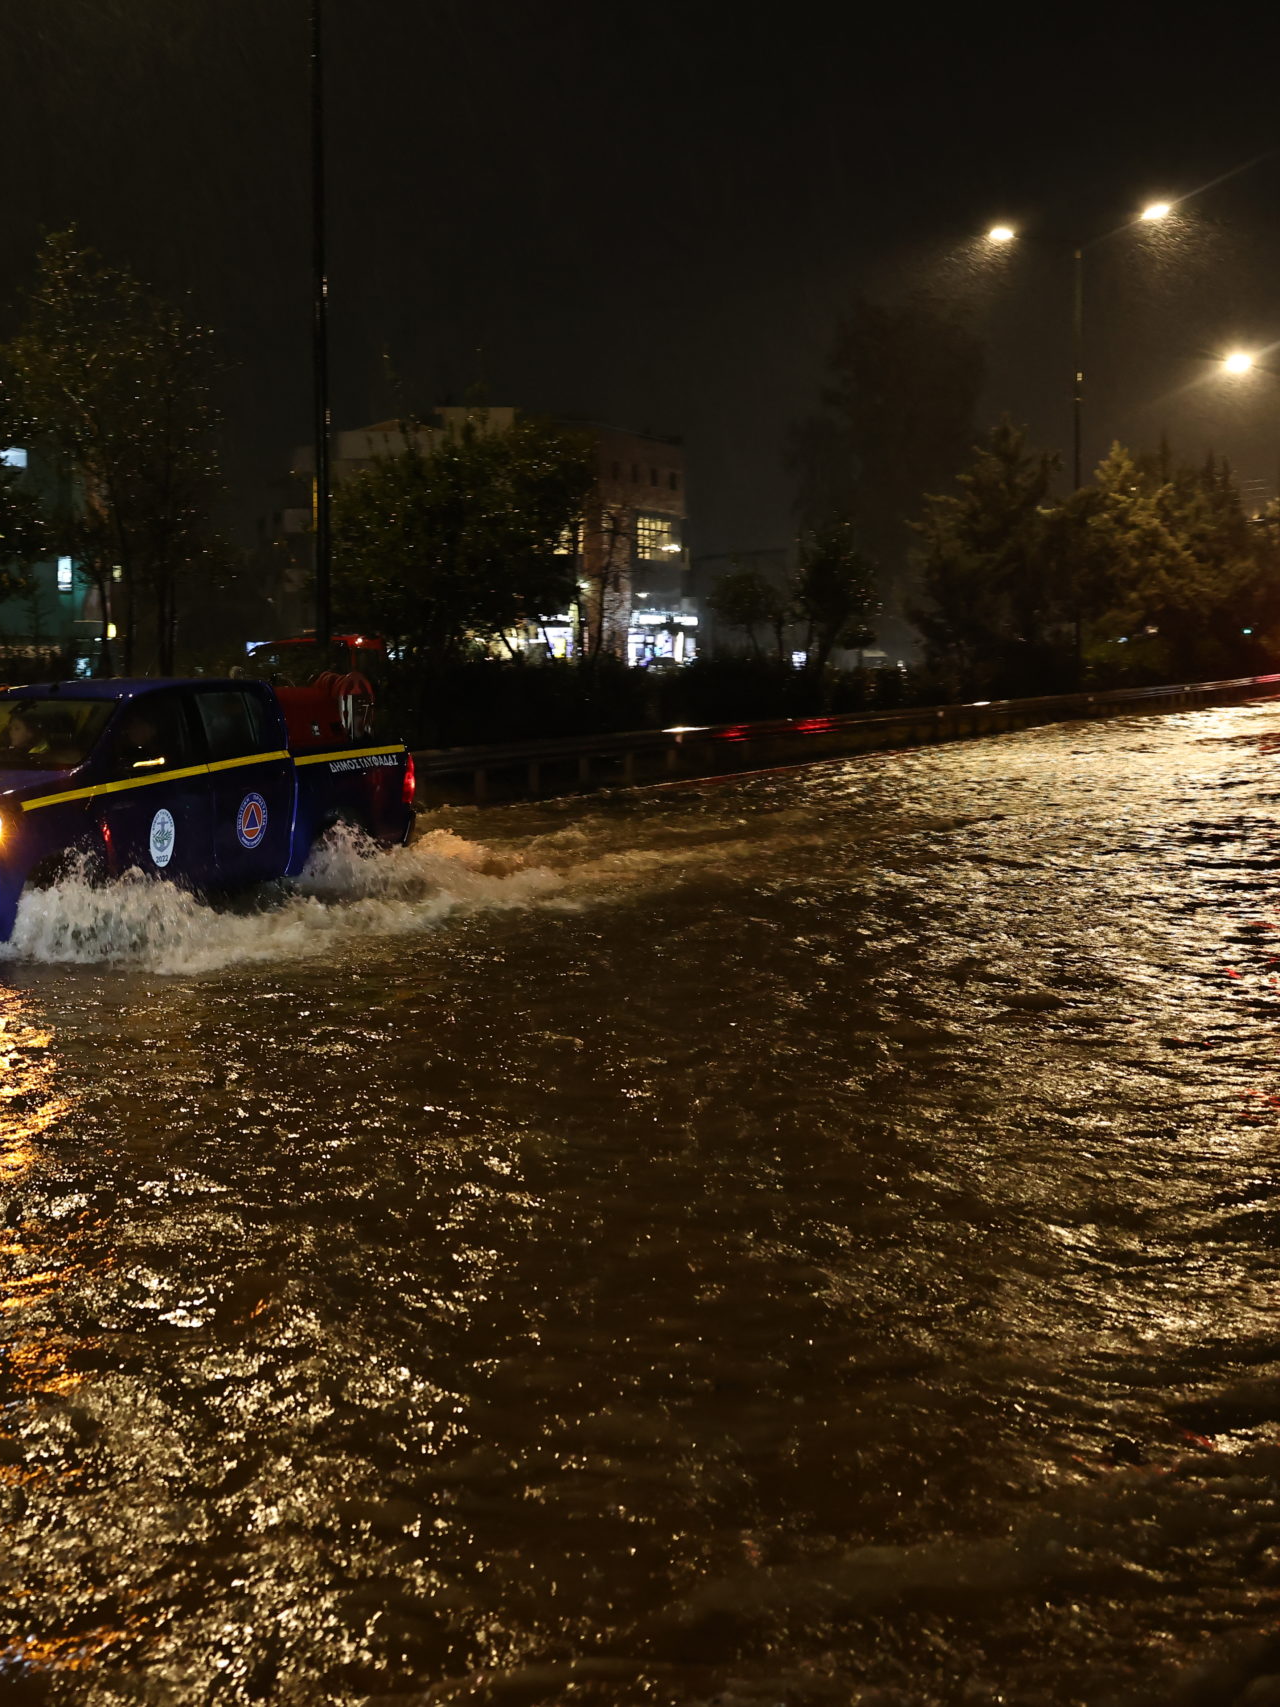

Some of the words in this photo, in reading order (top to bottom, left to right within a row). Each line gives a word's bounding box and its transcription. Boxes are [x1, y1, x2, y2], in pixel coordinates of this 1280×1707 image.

[328, 758, 361, 773] ΔΗΜΟΣ
[359, 754, 399, 769] ΓΛΥΦΑΔΑΣ
[155, 854, 169, 863] 2022
